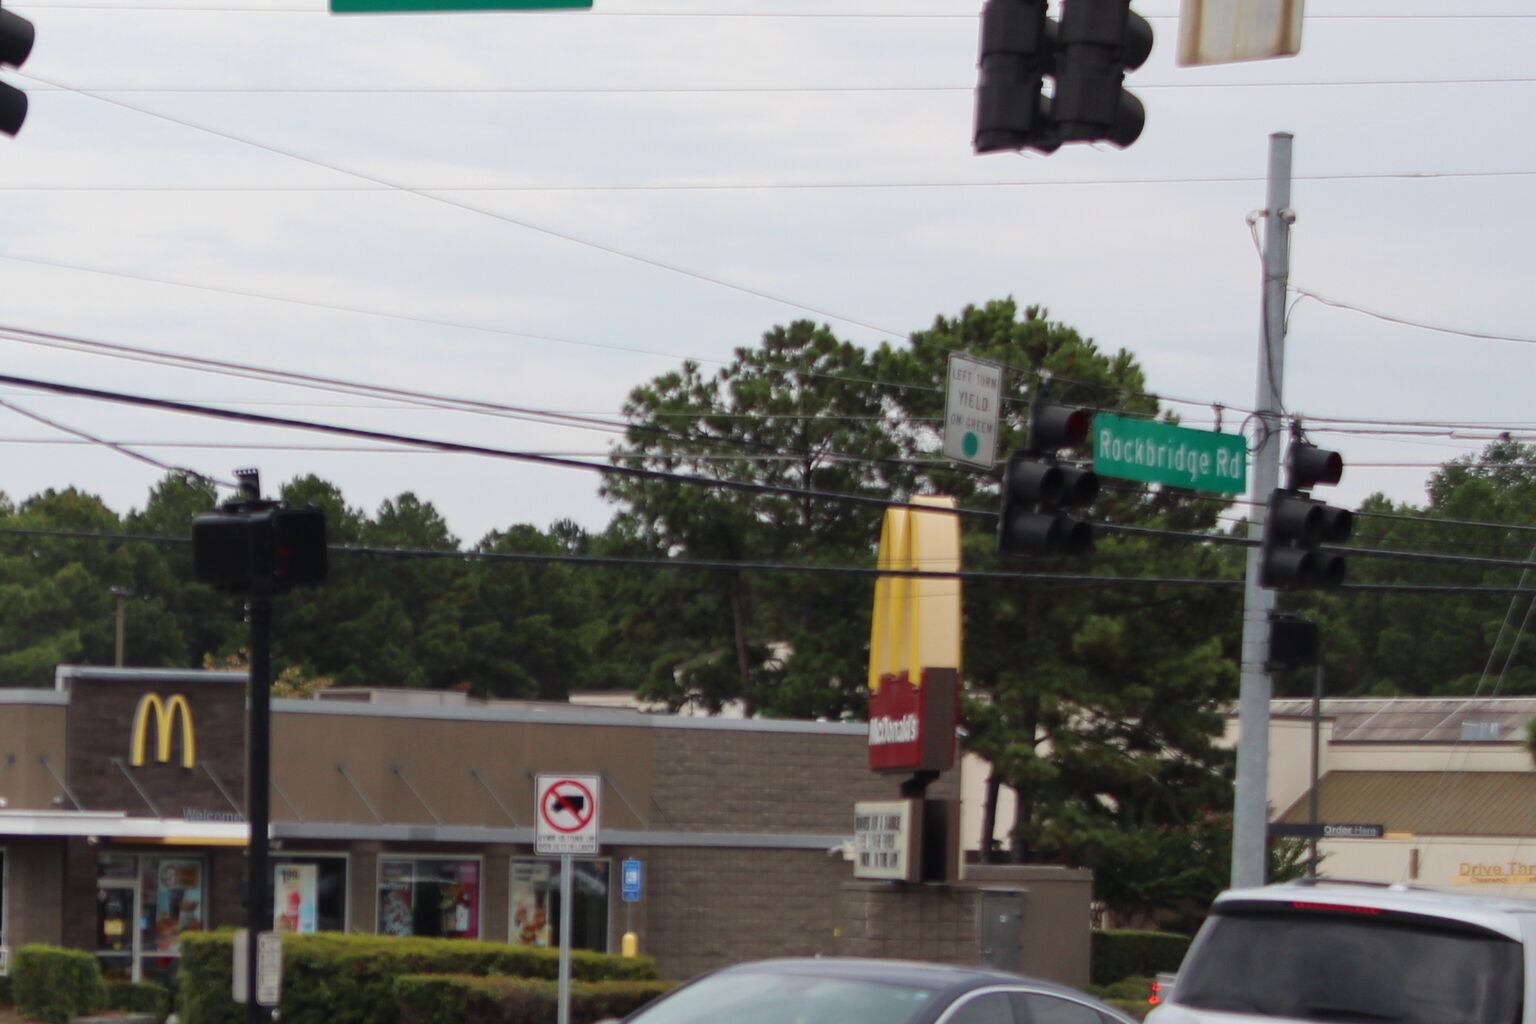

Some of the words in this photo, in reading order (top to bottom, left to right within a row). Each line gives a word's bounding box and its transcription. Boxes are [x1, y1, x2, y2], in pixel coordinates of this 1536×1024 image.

[952, 368, 973, 382] LEFT
[976, 373, 997, 389] TURN
[958, 391, 989, 412] YIELD
[1099, 429, 1211, 482] Rockbridge
[1215, 447, 1241, 479] Rd
[868, 713, 919, 746] McDonald's
[1323, 824, 1353, 836] Order
[1459, 861, 1503, 876] Drive
